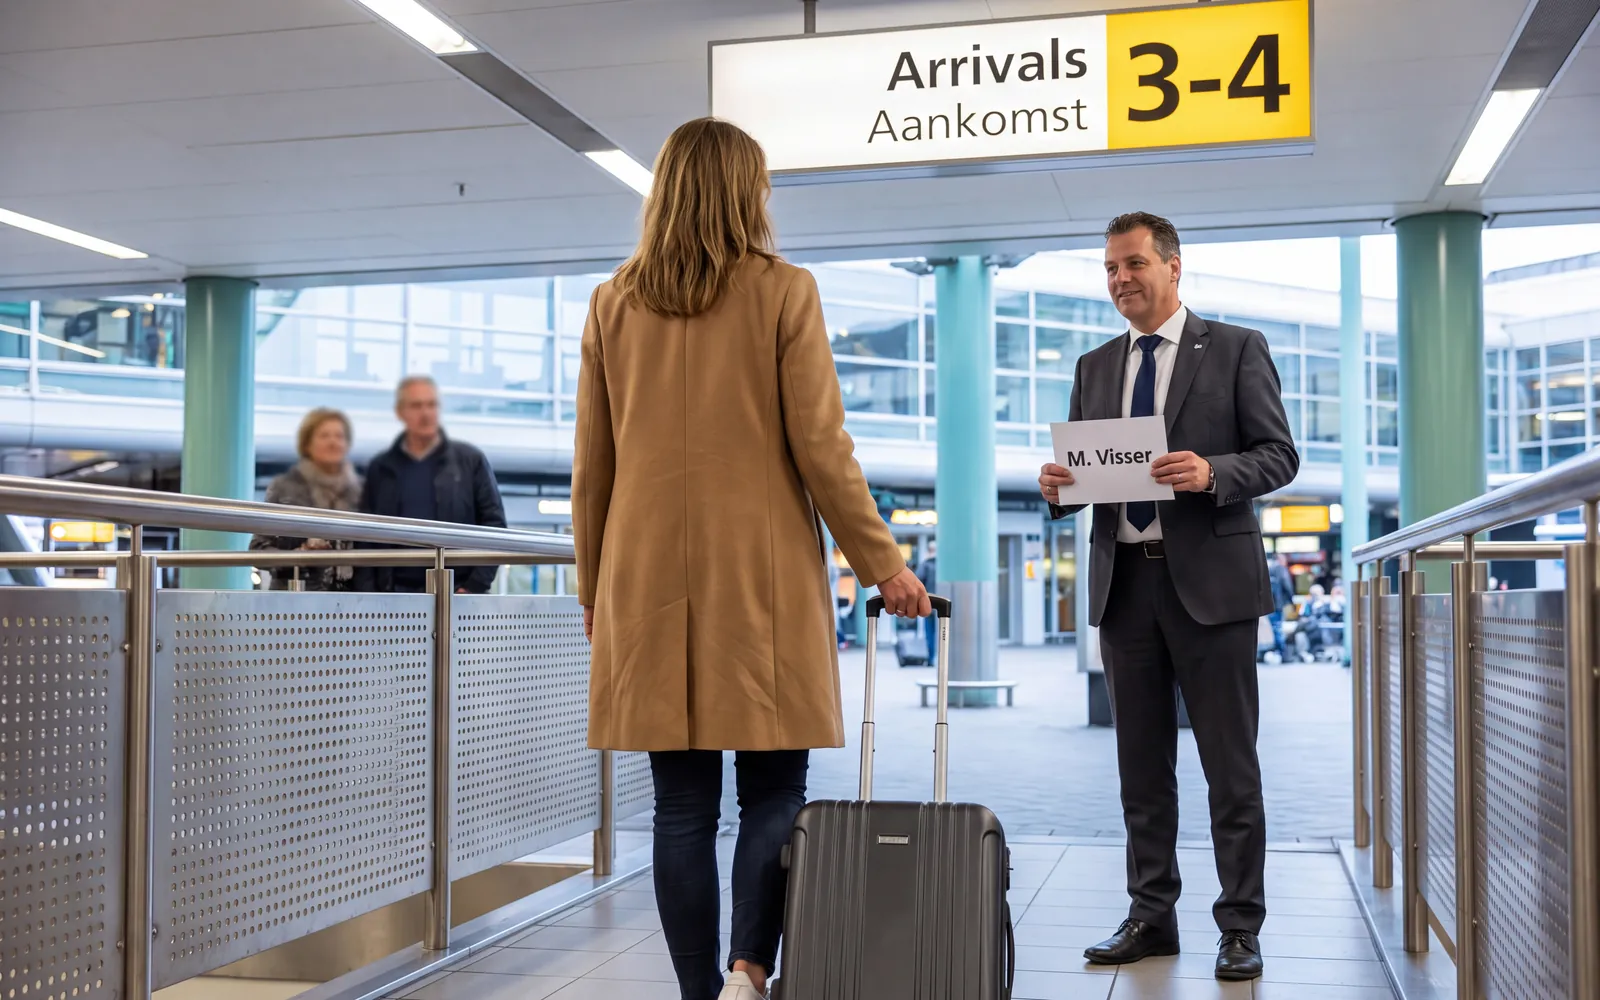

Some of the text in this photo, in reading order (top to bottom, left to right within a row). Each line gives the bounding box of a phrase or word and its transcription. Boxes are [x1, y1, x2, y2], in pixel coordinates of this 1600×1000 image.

[887, 38, 1088, 91] Arrivals
[1128, 33, 1291, 122] 3-4
[867, 99, 1088, 144] Aankomst
[1067, 448, 1152, 467] M. Visser
